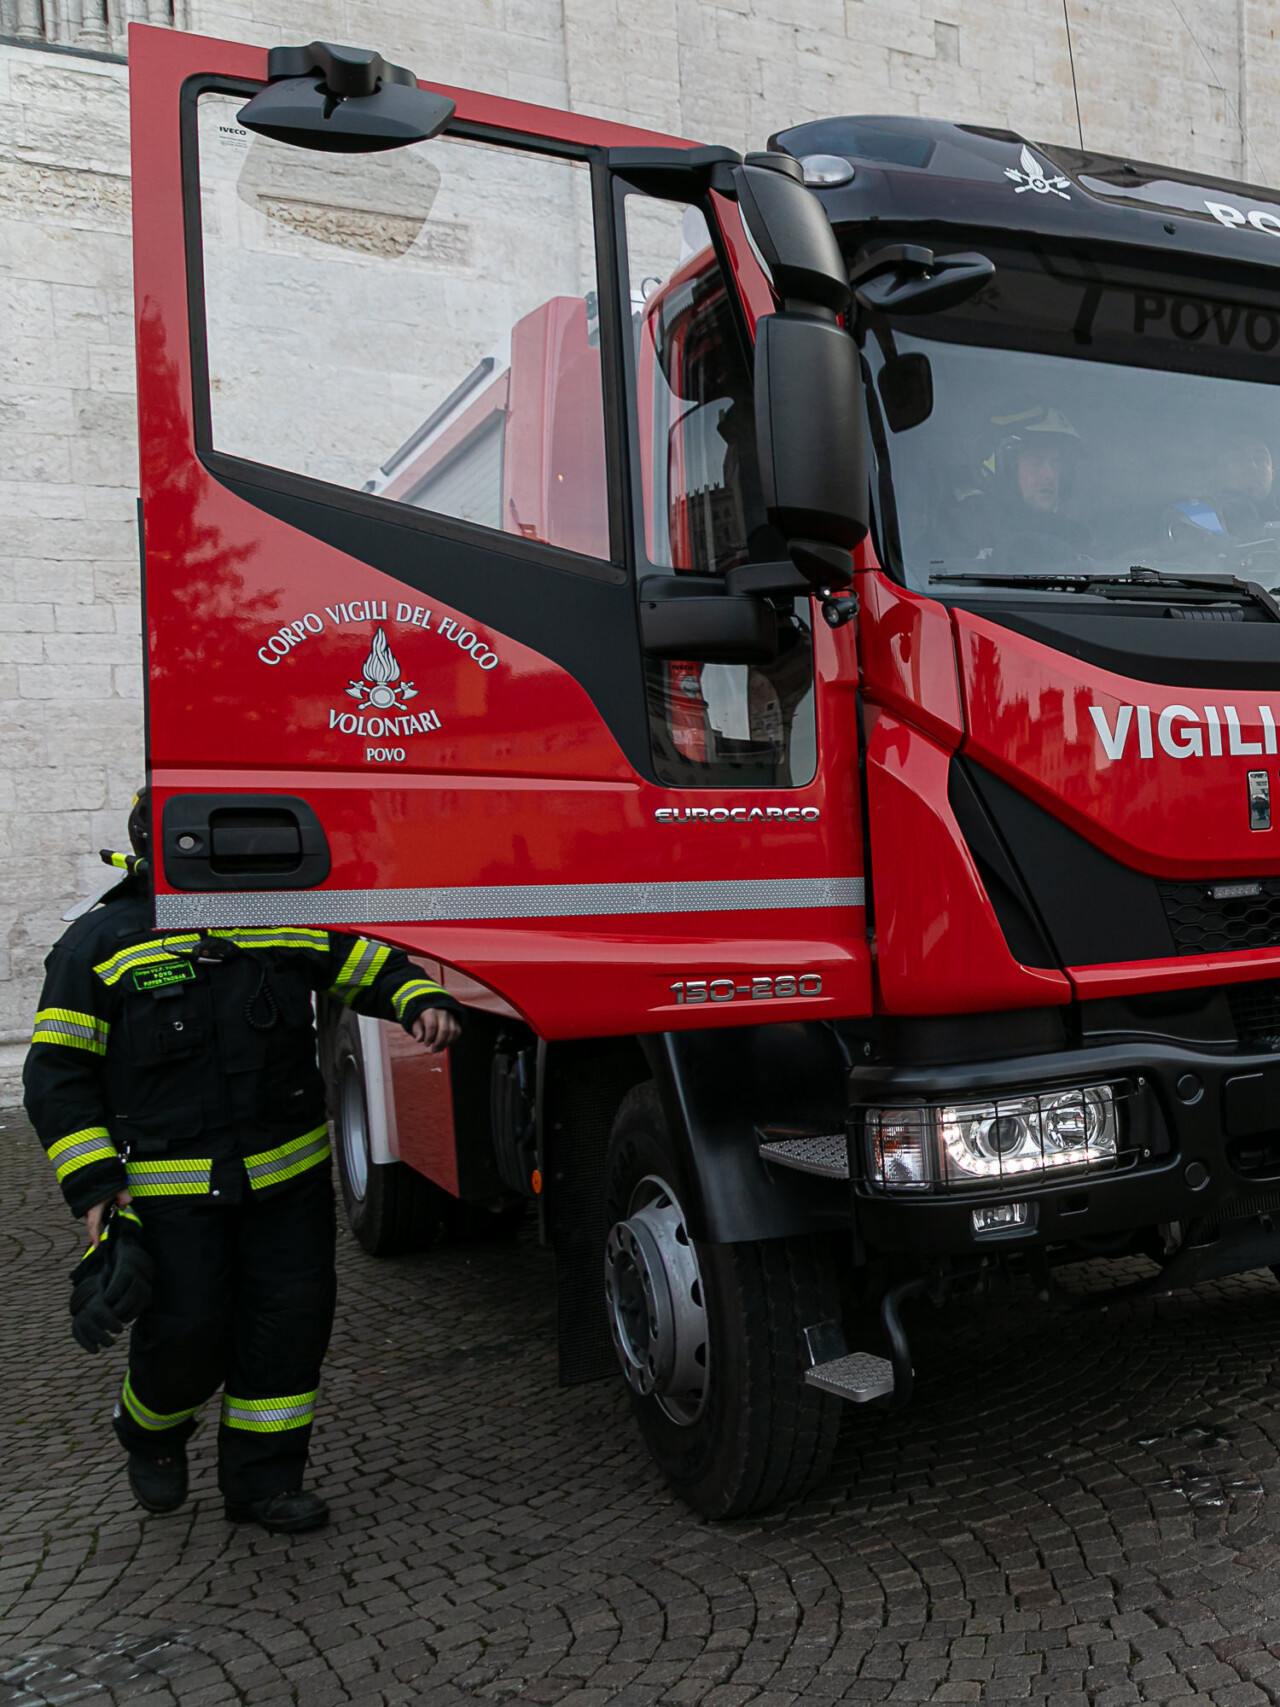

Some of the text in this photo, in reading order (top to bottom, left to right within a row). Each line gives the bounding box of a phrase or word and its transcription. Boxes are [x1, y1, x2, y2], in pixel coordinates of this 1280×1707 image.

[219, 126, 247, 136] IVECO
[1133, 293, 1280, 352] POVO
[257, 600, 499, 670] CORPO VIGILI DEL FUOCO
[328, 708, 442, 738] VOLONTARI
[1088, 704, 1278, 760] VIGILI
[366, 748, 406, 762] POVO
[654, 806, 820, 823] EUROCARGO
[669, 974, 823, 1005] 150-280
